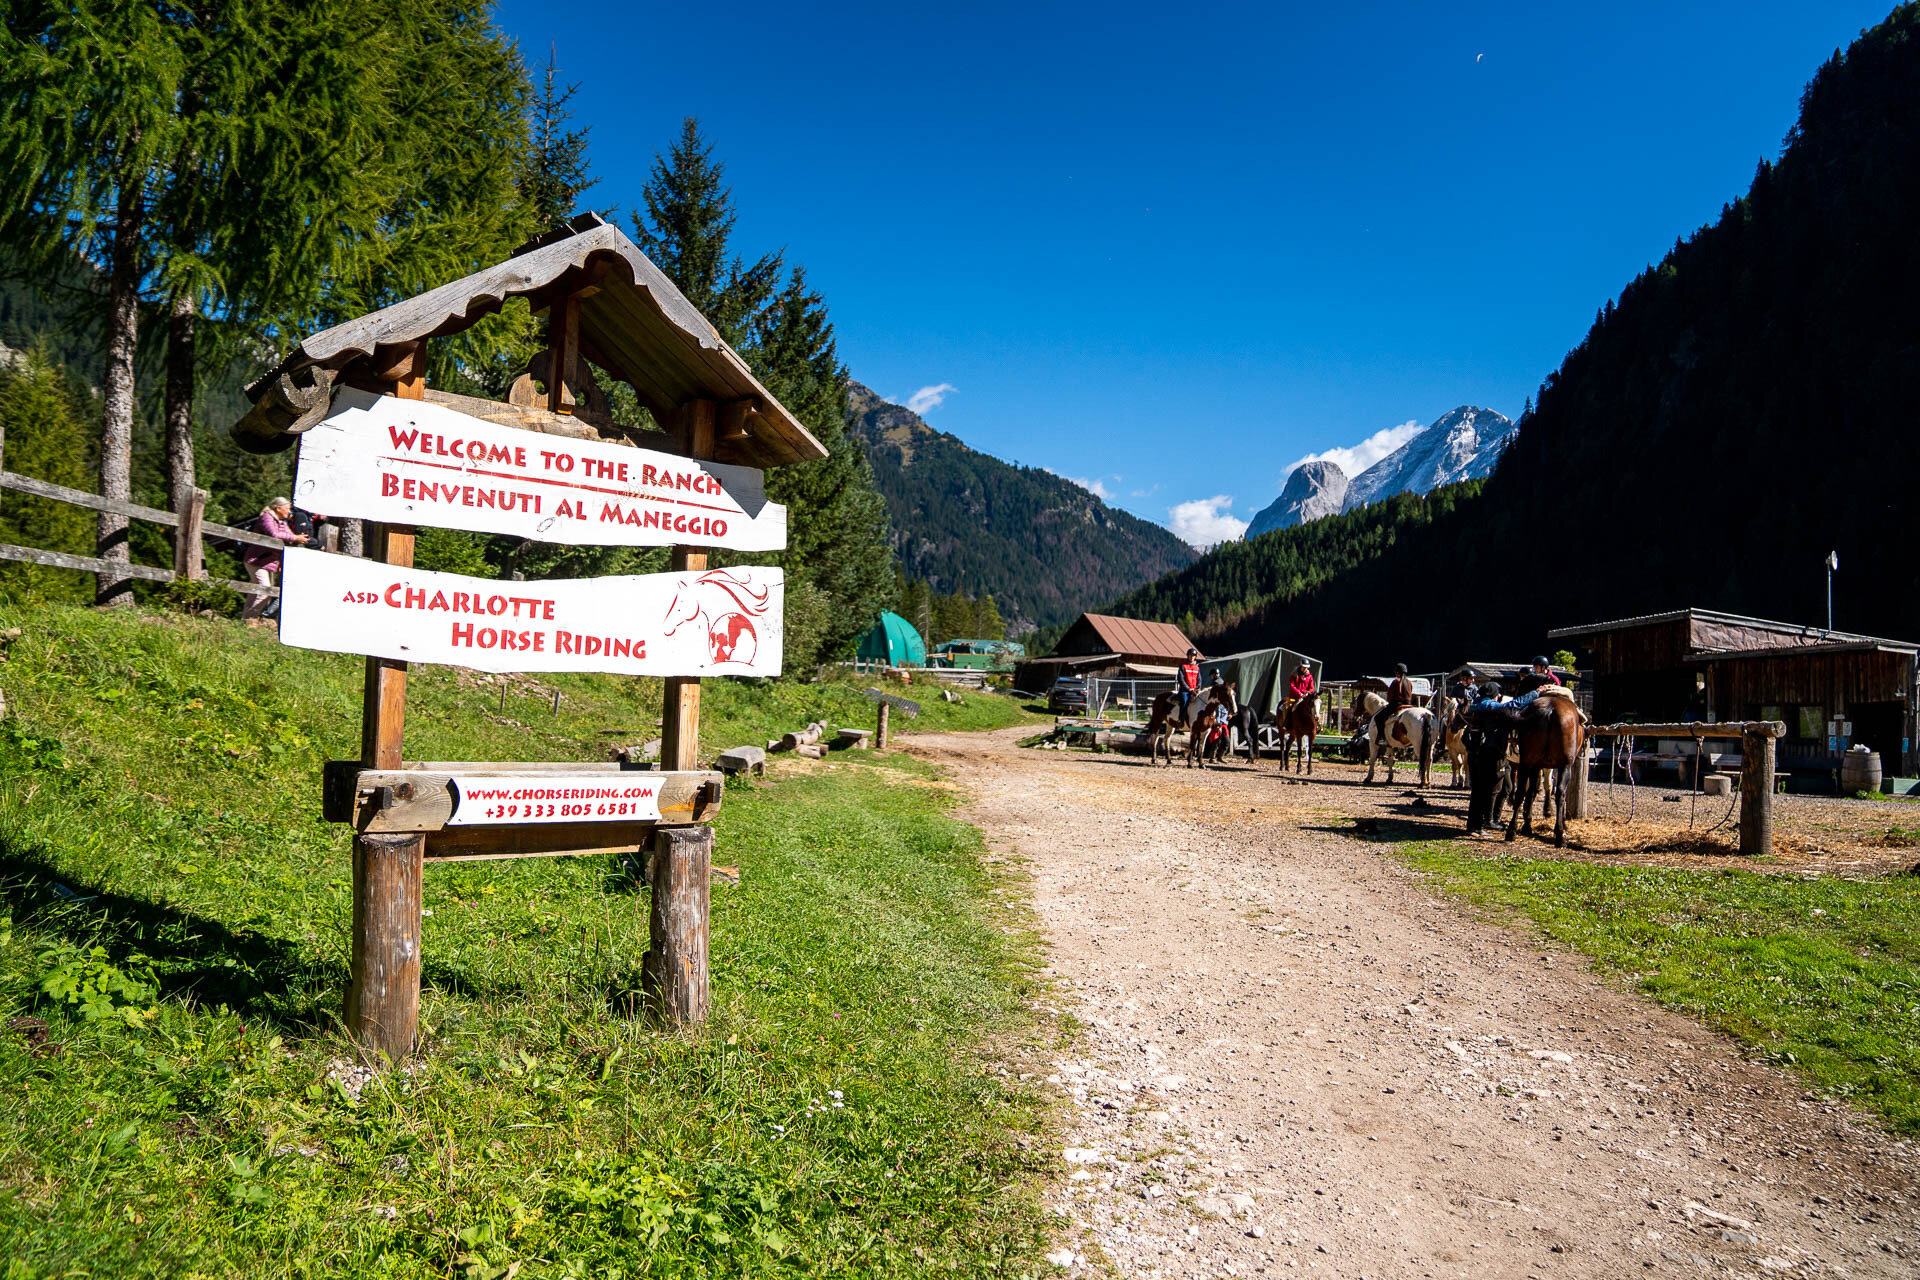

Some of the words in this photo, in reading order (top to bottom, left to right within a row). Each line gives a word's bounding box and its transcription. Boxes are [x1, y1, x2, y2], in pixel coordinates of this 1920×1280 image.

[388, 425, 527, 467] WELCOME
[540, 451, 574, 472] TO
[581, 458, 628, 482] THE
[640, 464, 721, 496] RANCH
[381, 473, 542, 514] BENVENUTI
[555, 498, 587, 520] AL
[600, 504, 728, 537] MANEGGIO
[344, 592, 378, 604] ASD
[384, 583, 555, 620] CHARLOTTE
[452, 622, 544, 651] HORSE
[555, 631, 646, 659] RIDING
[467, 788, 652, 800] WWW.CHORSERIDING.COM
[485, 805, 517, 818] +39
[523, 805, 555, 817] 333
[561, 804, 591, 816] 805
[597, 803, 636, 815] 6581
